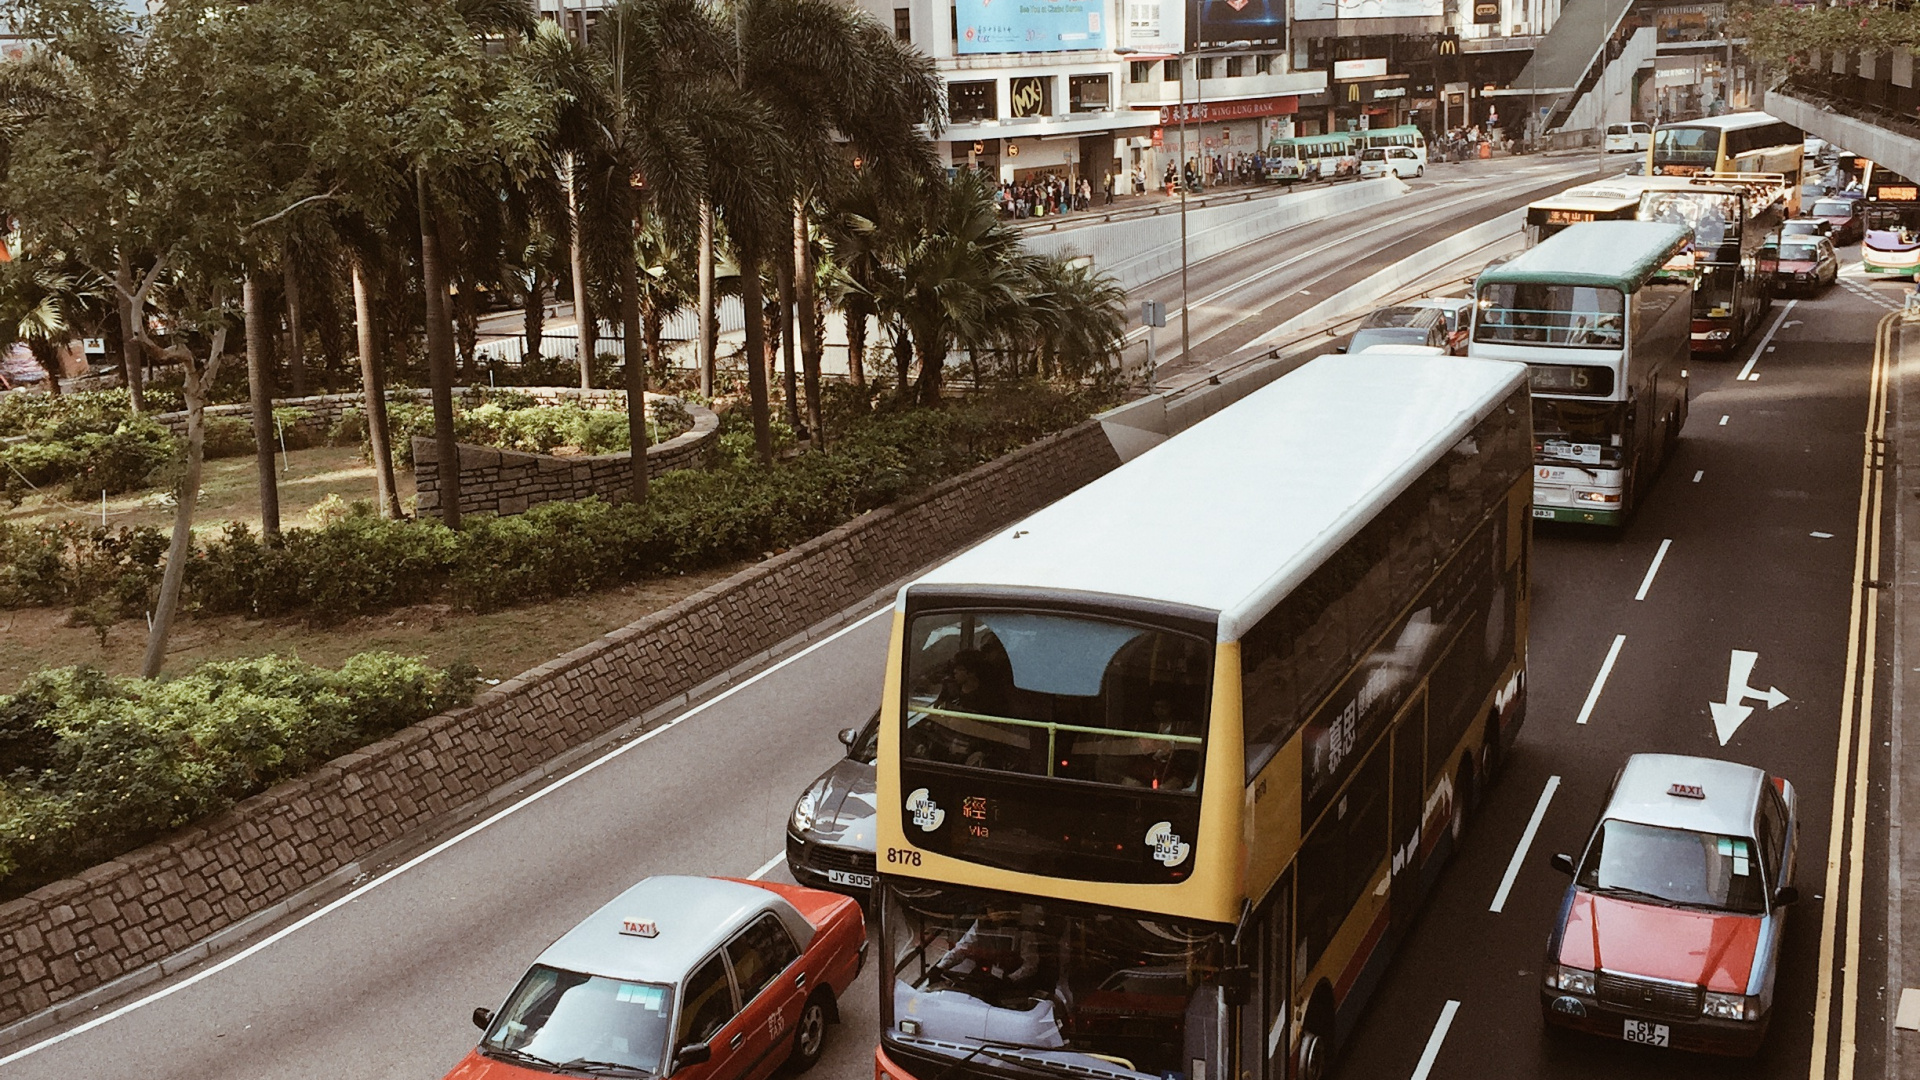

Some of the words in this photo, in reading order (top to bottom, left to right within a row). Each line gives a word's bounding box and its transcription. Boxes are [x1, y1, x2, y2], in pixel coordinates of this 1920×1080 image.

[1211, 107, 1230, 116] WING
[1232, 105, 1252, 115] LUNG
[1254, 103, 1273, 112] BANK
[1672, 783, 1701, 795] TAXI
[915, 809, 935, 820] BUS
[969, 821, 989, 838] via
[1156, 833, 1179, 845] WIFI
[1156, 843, 1179, 855] BUS
[887, 847, 921, 867] 8178
[831, 871, 845, 882] JY
[848, 873, 871, 886] 905
[623, 921, 650, 933] TAXI
[1637, 1021, 1656, 1034] GW
[1627, 1029, 1666, 1046] 8027
